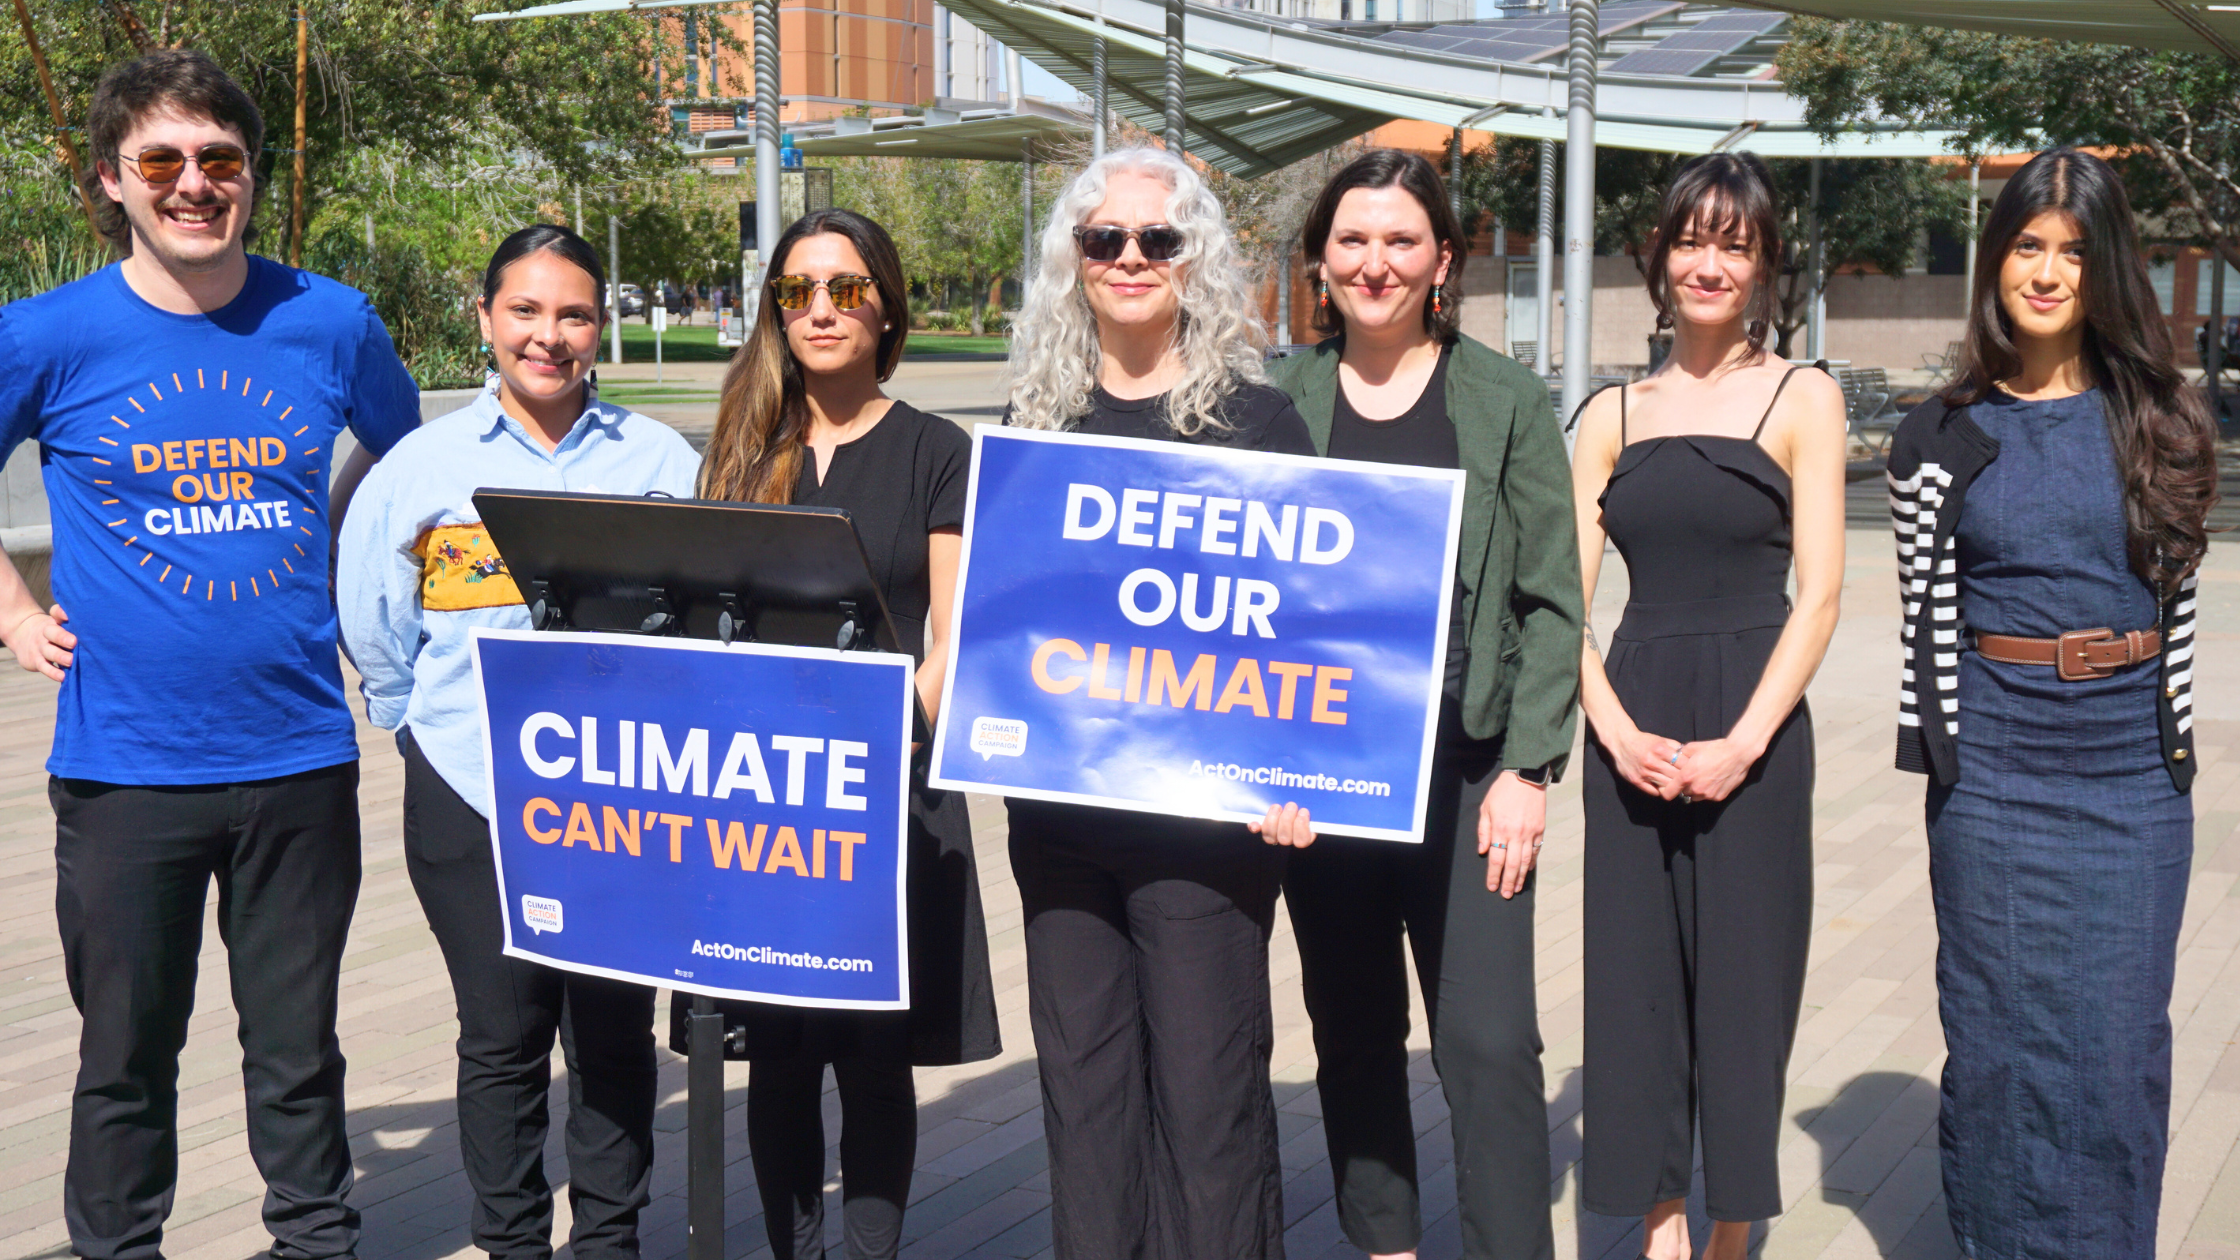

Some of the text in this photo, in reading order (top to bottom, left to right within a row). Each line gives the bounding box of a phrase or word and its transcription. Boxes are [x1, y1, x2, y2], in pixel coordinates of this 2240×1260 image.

[131, 437, 287, 474] DEFEND
[172, 471, 255, 503] OUR
[144, 500, 292, 535] CLIMATE
[1062, 482, 1355, 565] DEFEND
[1118, 567, 1281, 639] OUR
[1030, 637, 1353, 726] CLIMATE
[978, 739, 1018, 749] CAMPAIGN
[979, 731, 1019, 743] ACTION
[980, 722, 1020, 734] CLIMATE
[519, 711, 869, 811] CLIMATE
[1188, 759, 1391, 797] ActOnClimate.com
[522, 796, 867, 882] CAN'T WAIT
[527, 900, 556, 912] CLIMATE
[528, 908, 557, 920] ACTION
[528, 915, 557, 926] CAMPAIGN
[691, 939, 873, 972] ActOnClimate.com
